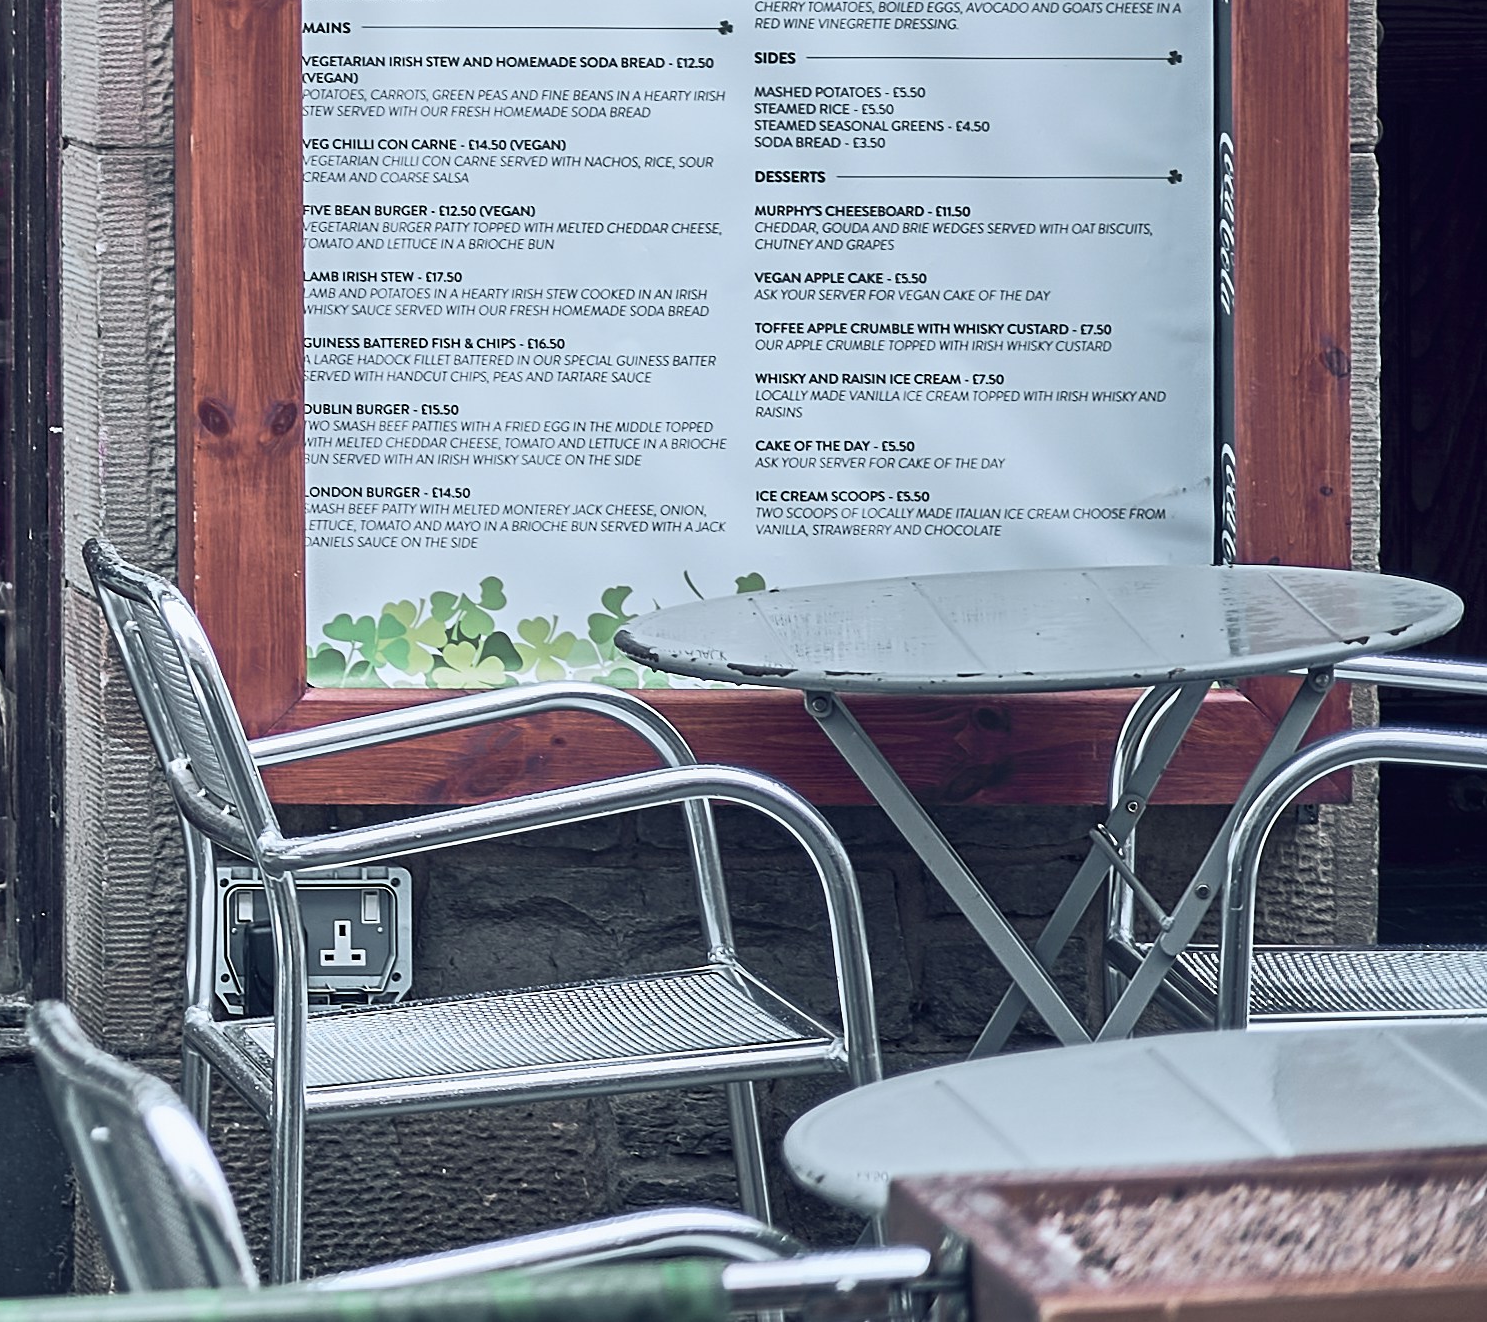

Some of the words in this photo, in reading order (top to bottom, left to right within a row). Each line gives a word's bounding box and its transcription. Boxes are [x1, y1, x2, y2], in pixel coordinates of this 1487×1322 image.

[302, 22, 352, 35] MAINS
[753, 51, 797, 65] SIDES
[754, 170, 827, 184] DESSERTS
[302, 204, 332, 217] FIVE
[334, 204, 371, 217] BEAN
[374, 204, 428, 217] BURGER
[438, 204, 477, 217] £12.50
[479, 205, 536, 218] (VEGAN)
[754, 204, 823, 217] MURPHY'S
[824, 205, 925, 218] CHEESEBOARD
[935, 205, 972, 218] £11.50
[755, 439, 792, 452] CAKE
[793, 440, 814, 452] OF
[814, 440, 841, 452] THE
[843, 440, 871, 452] DAY
[881, 440, 916, 453] £5.50
[755, 490, 778, 503] ICE
[779, 490, 829, 503] CREAM
[830, 490, 886, 503] SCOOPS
[896, 490, 931, 503] £5.50
